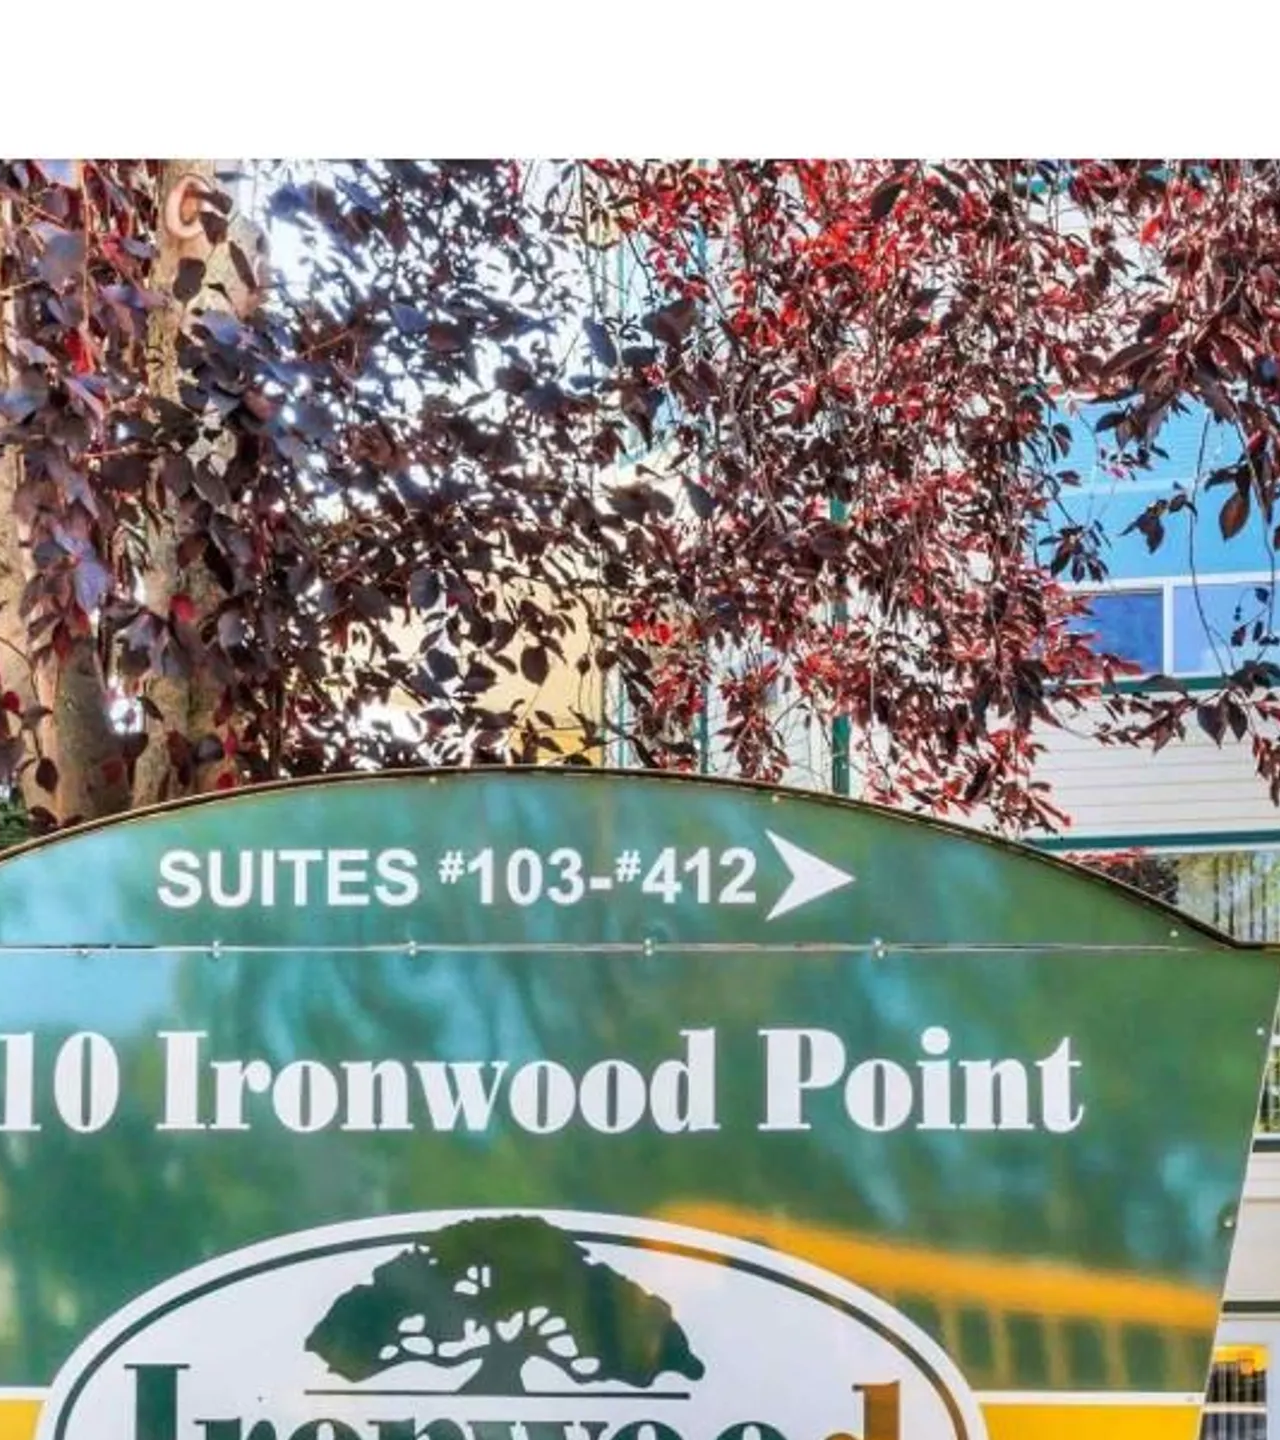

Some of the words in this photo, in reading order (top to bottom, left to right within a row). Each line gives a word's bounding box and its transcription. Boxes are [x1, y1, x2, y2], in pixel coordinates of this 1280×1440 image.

[157, 848, 419, 908] SUITES
[438, 847, 757, 906] #103-#412
[156, 1028, 720, 1134] Ironwood
[758, 1026, 1085, 1133] Point
